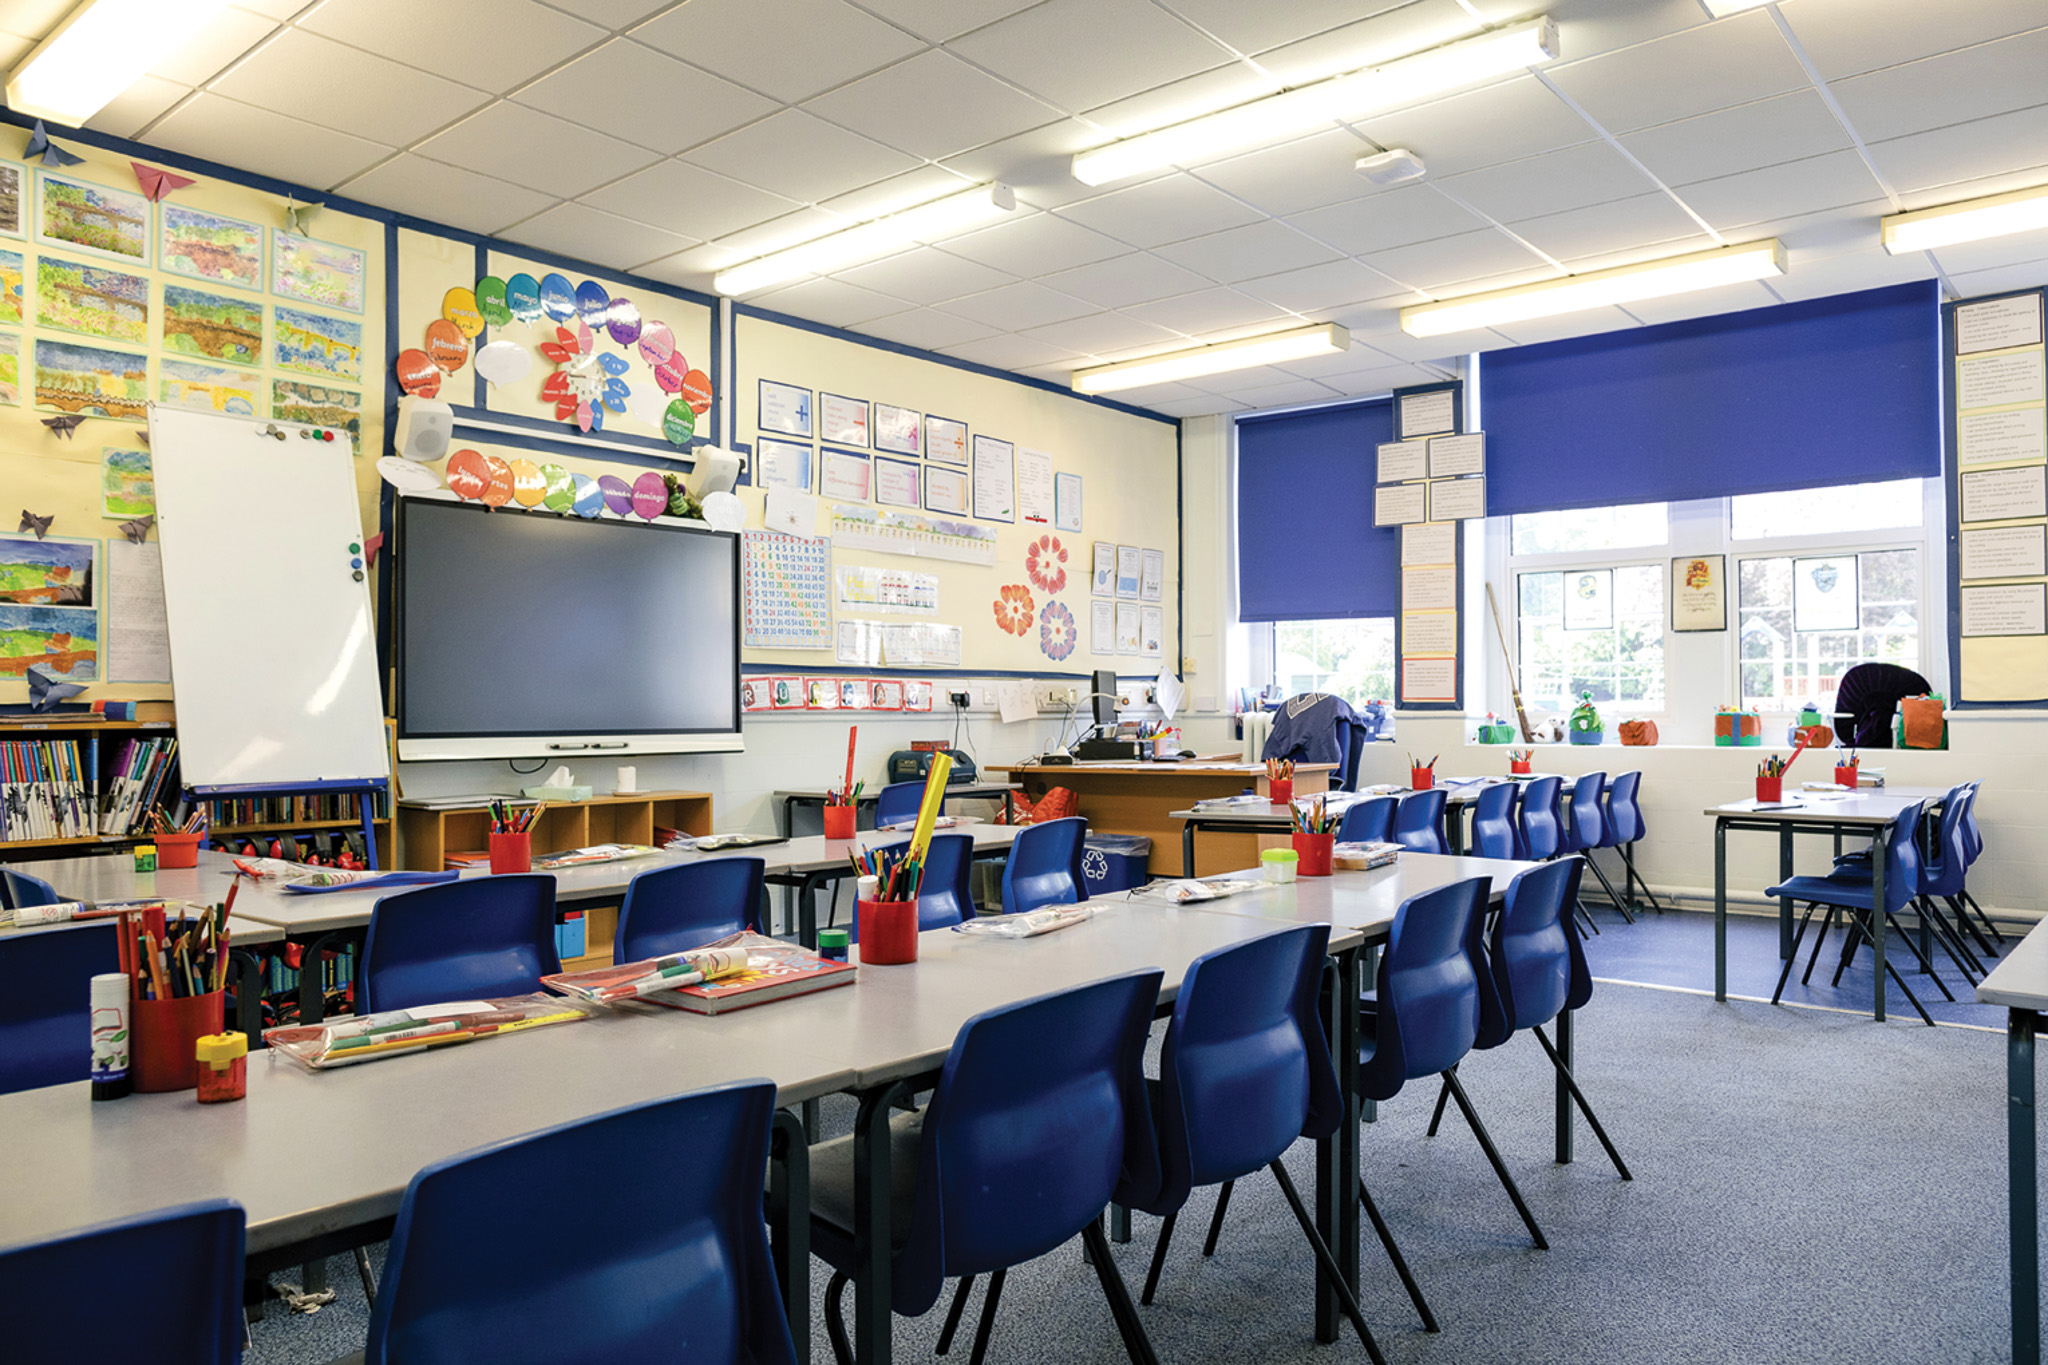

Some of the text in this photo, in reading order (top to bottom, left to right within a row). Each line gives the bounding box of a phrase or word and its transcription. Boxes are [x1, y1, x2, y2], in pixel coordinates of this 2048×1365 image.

[486, 295, 505, 307] abril
[514, 292, 538, 305] mayo
[548, 290, 569, 302] junio
[584, 298, 602, 310] julio
[450, 308, 478, 318] marzo
[432, 337, 464, 352] febrero
[683, 383, 712, 400] noviembre
[634, 491, 665, 502] domingo
[847, 576, 874, 589] Place
[846, 589, 876, 601] Value
[745, 690, 752, 702] R
[780, 688, 787, 700] U
[878, 689, 885, 703] A
